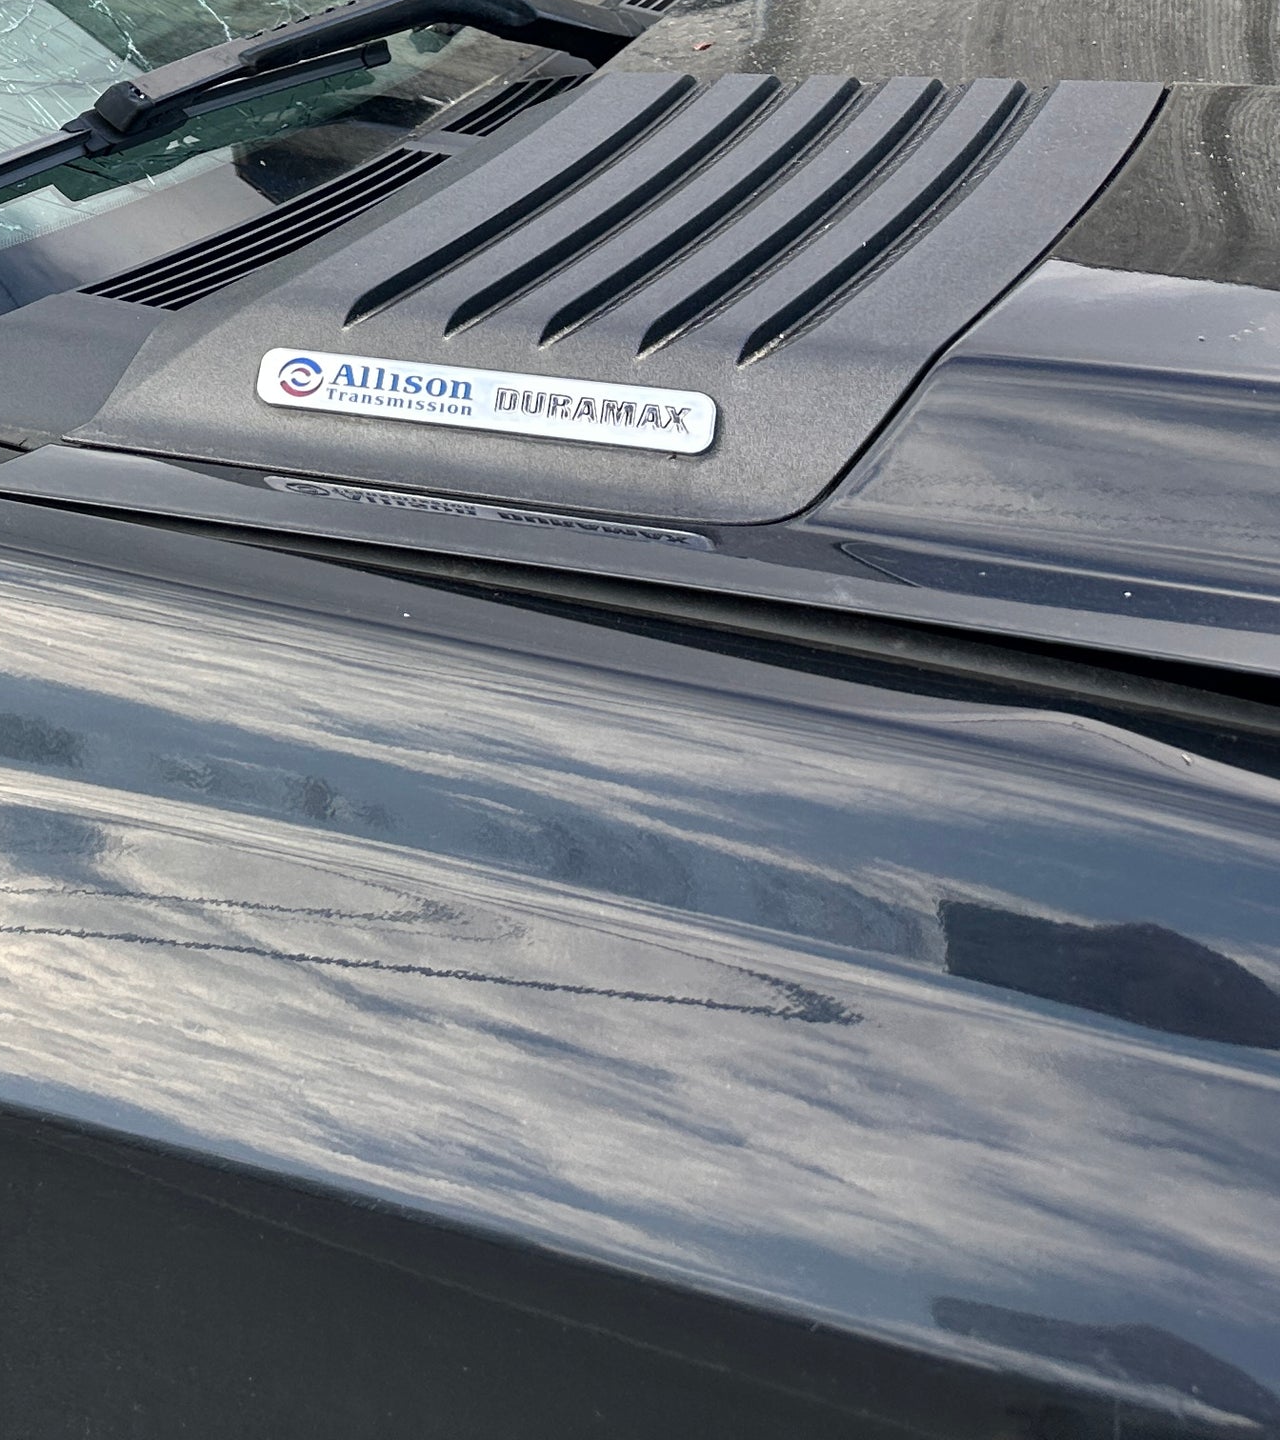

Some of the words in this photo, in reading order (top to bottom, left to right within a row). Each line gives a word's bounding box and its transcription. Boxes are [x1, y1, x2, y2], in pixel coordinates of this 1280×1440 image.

[326, 387, 473, 417] Transmission
[329, 363, 474, 401] Allison
[493, 387, 692, 435] DURAMAX
